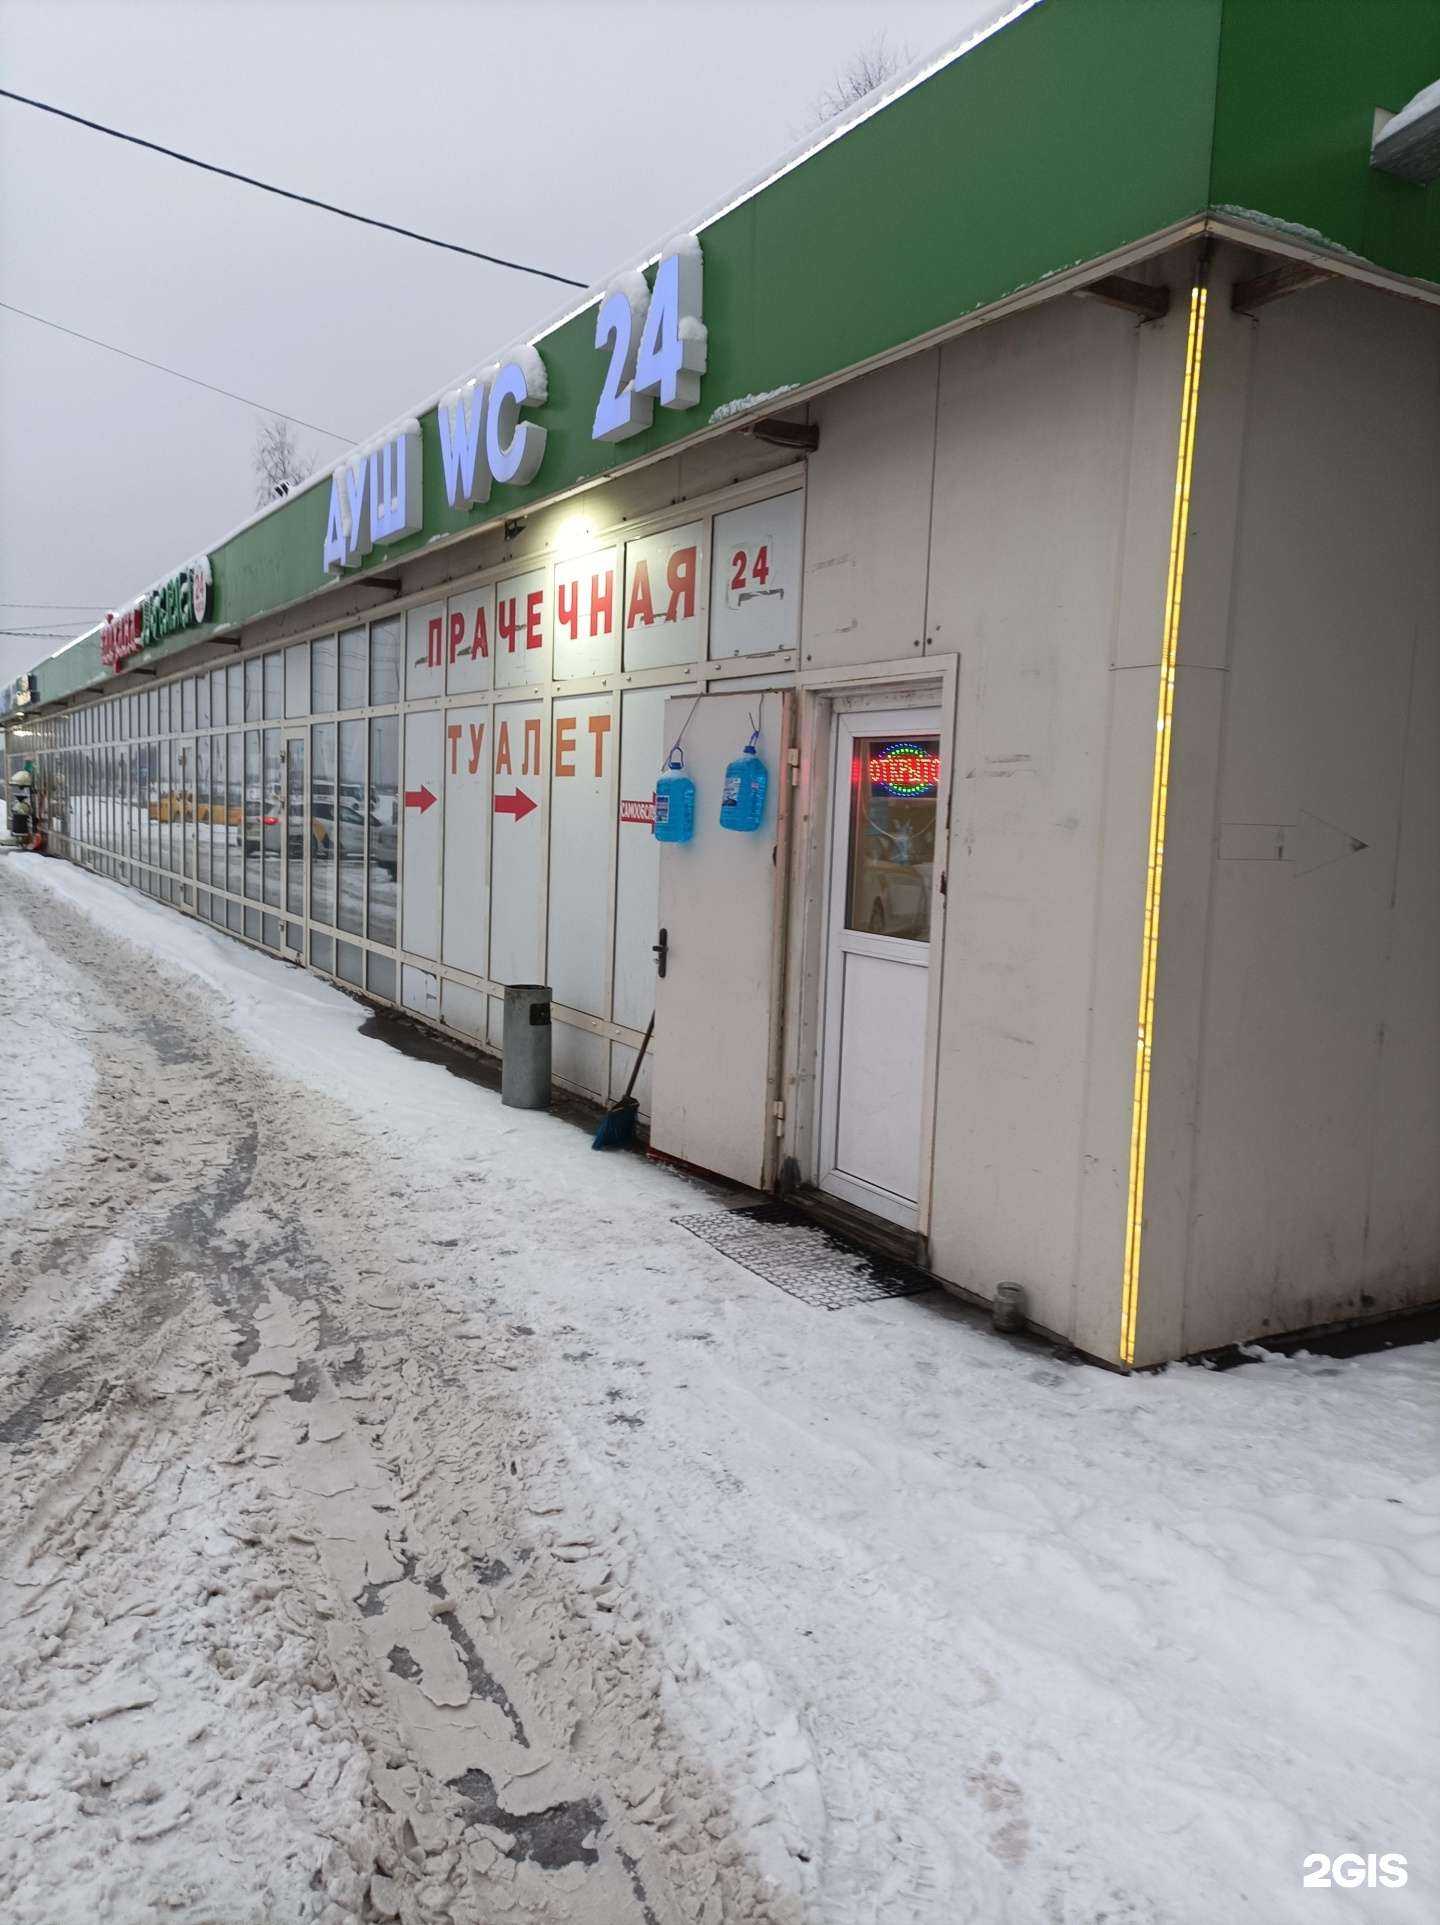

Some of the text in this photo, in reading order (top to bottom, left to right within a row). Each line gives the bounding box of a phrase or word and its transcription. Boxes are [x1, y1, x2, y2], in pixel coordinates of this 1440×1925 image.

[323, 254, 687, 575] ДУШ WC 24
[427, 545, 770, 668] ПРАЧЕЧНАЯ 24
[447, 714, 612, 778] ТУАЛЕТ
